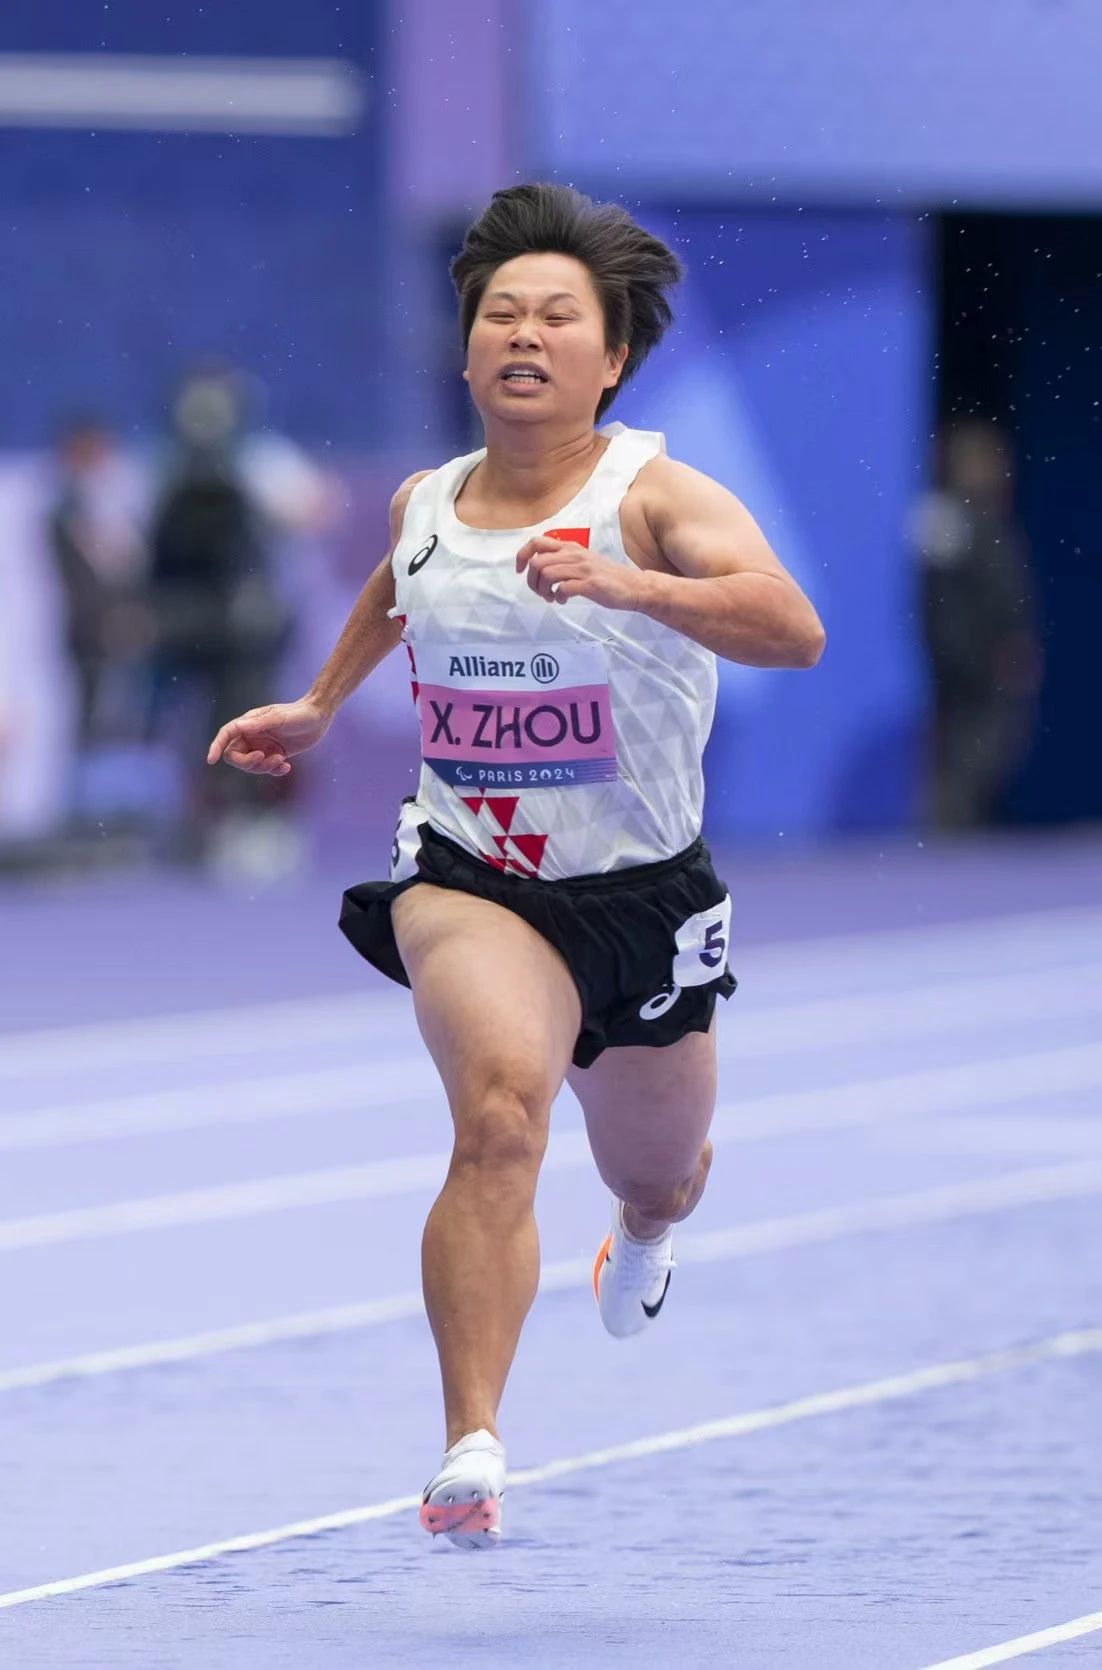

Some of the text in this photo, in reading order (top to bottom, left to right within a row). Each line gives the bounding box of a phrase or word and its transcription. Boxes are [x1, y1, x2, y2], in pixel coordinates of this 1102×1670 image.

[449, 656, 525, 677] Allianz
[430, 700, 601, 748] X. ZHOU
[478, 767, 575, 783] PARIS 2024
[698, 919, 725, 968] 5
